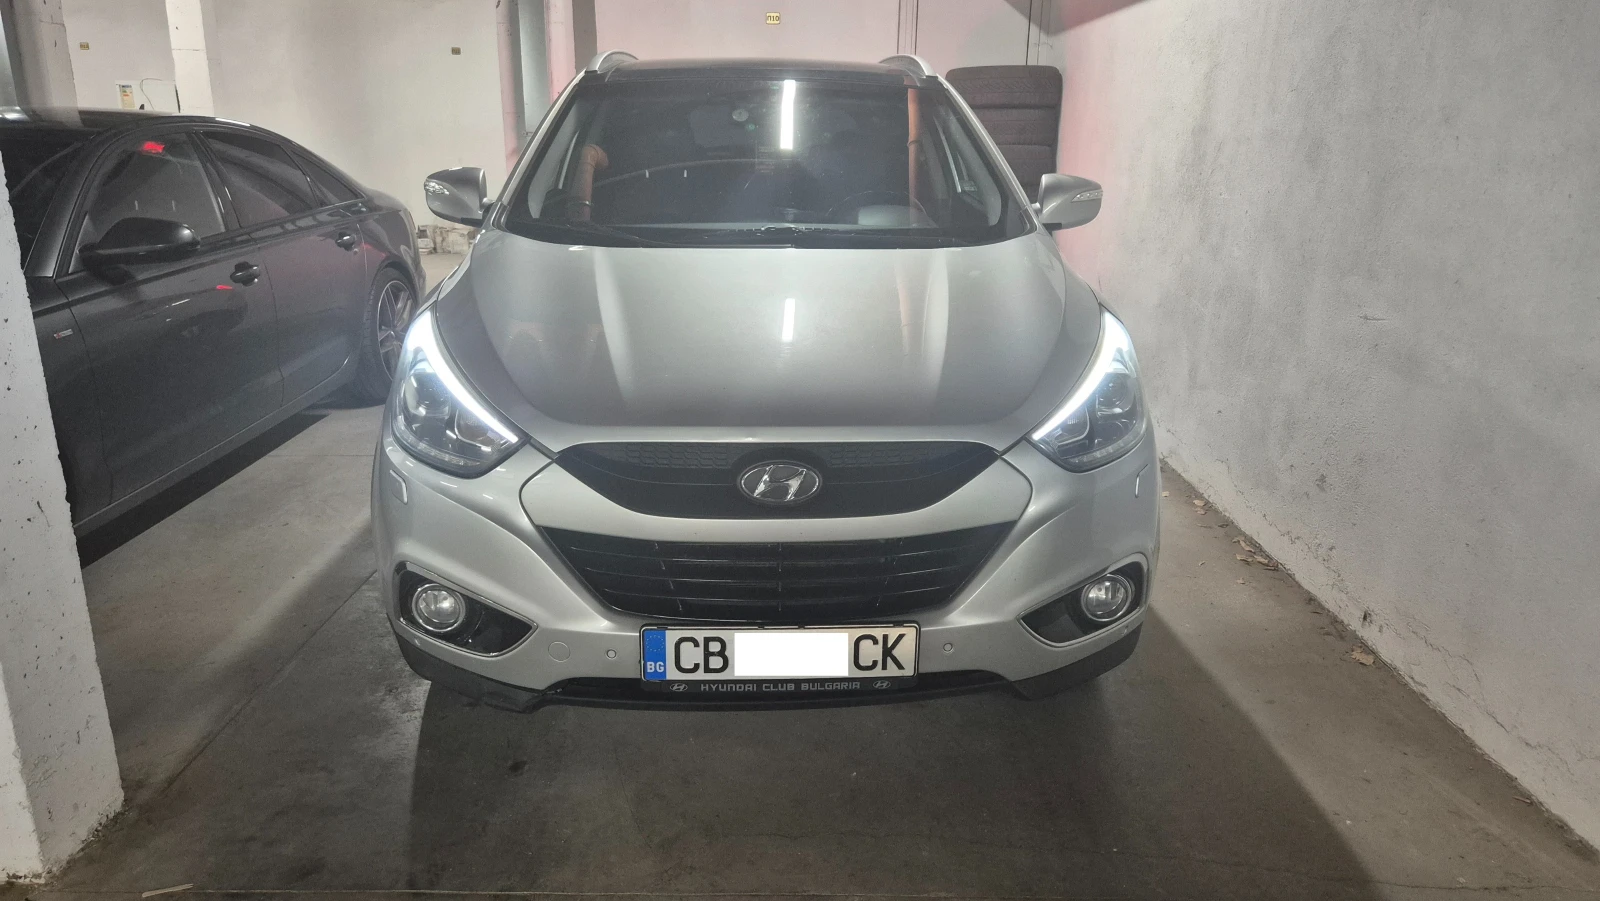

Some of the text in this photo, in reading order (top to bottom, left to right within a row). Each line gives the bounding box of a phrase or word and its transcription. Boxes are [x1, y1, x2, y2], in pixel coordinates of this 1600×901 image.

[674, 633, 907, 674] CB CK
[646, 661, 665, 673] BG
[700, 681, 861, 692] HYUNDAI CLUB BULGARIA
